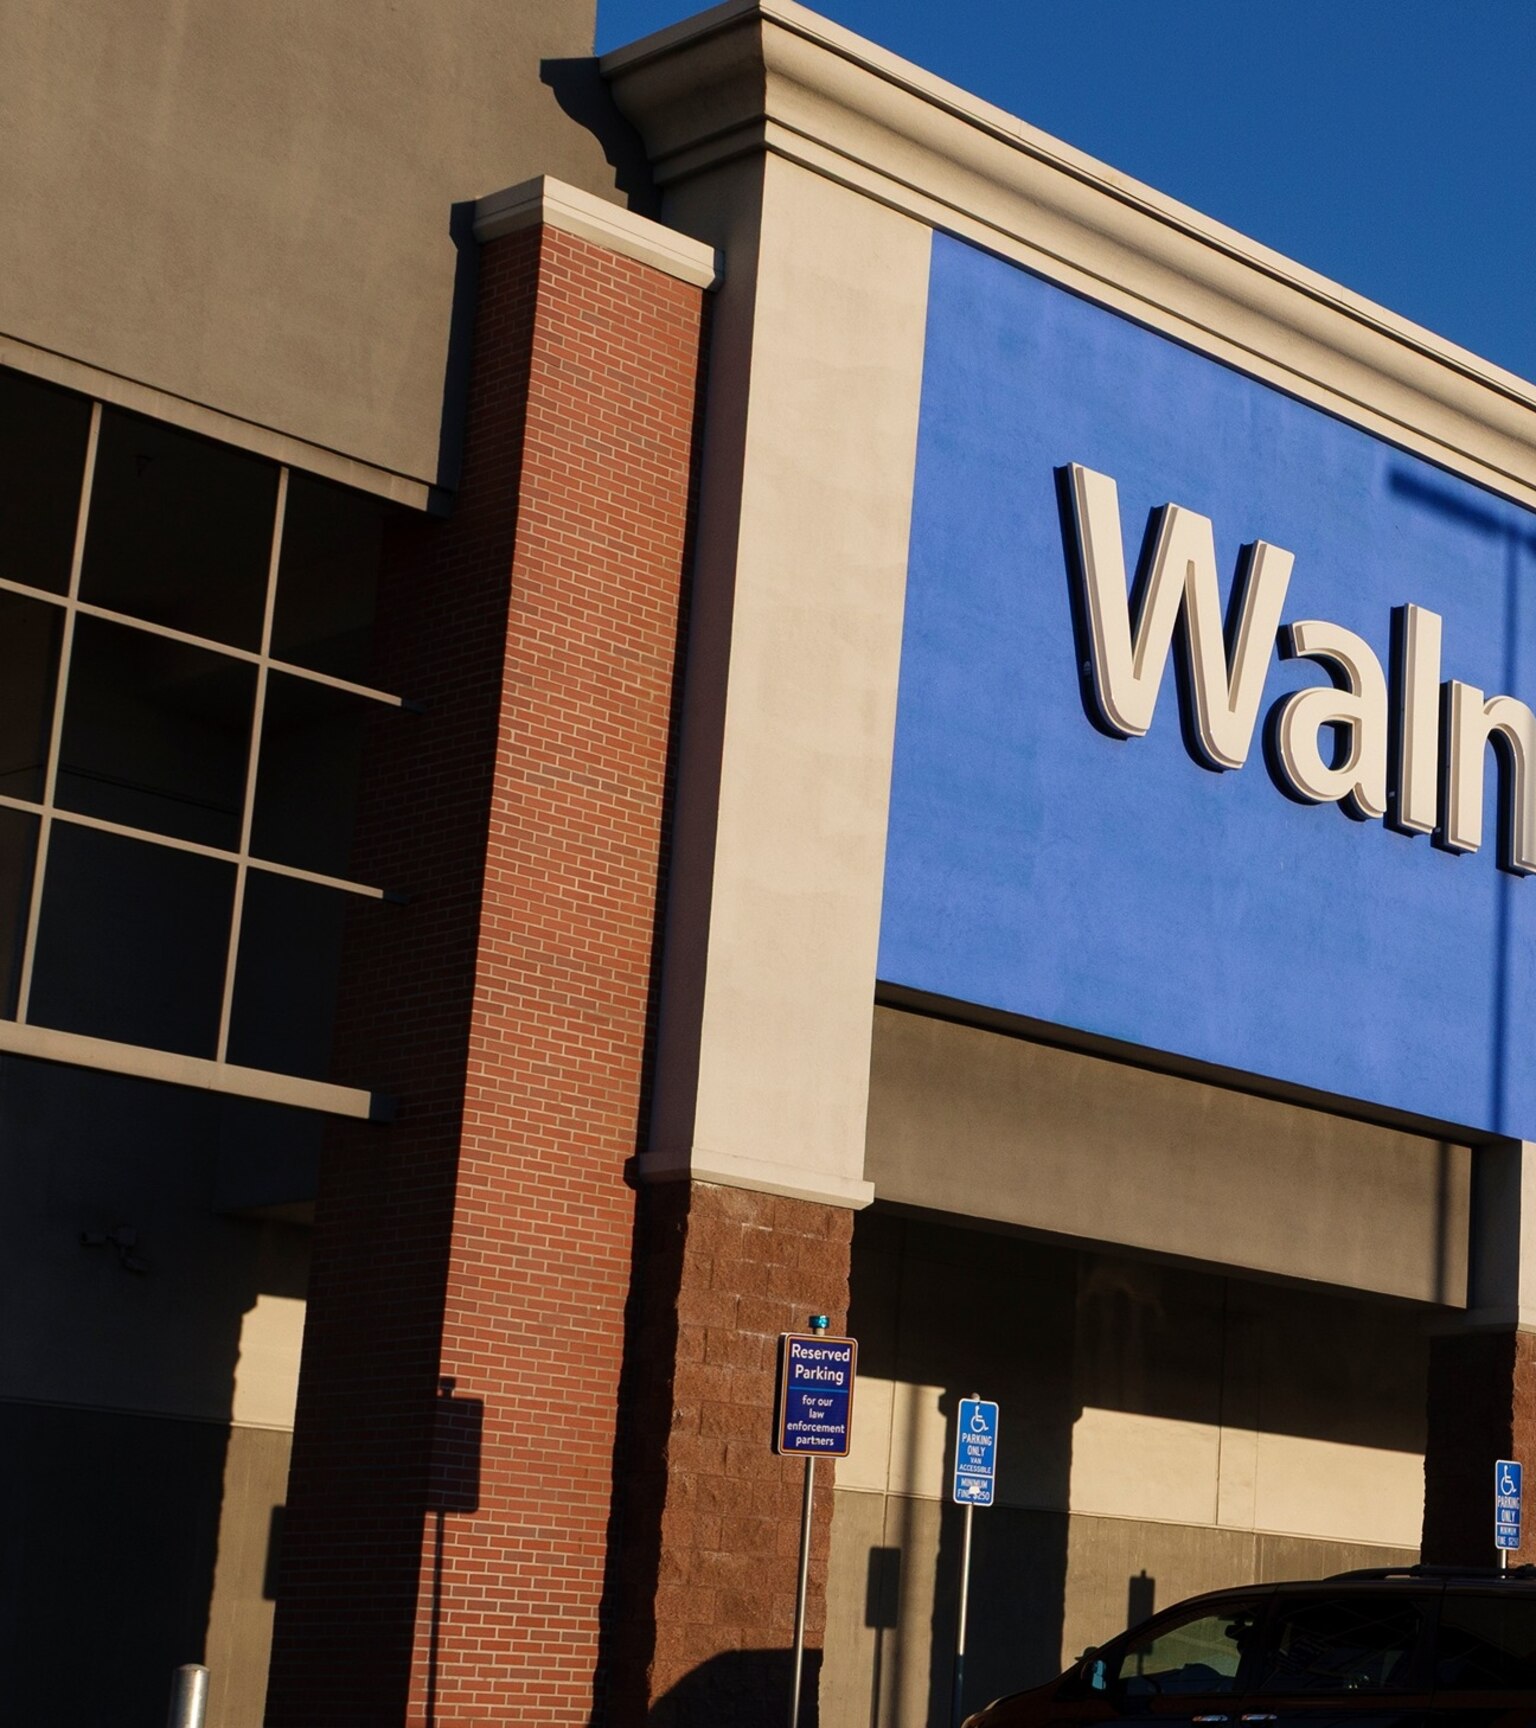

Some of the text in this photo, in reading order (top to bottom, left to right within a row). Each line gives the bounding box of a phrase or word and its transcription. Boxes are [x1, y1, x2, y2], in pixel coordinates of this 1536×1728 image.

[791, 1343, 850, 1362] Reserved
[795, 1364, 844, 1386] Parking
[802, 1395, 833, 1407] for our
[809, 1408, 825, 1419] law
[787, 1421, 845, 1434] enforcement
[795, 1436, 834, 1447] partners
[962, 1432, 993, 1447] PARKING
[967, 1445, 986, 1457] ONLY
[970, 1457, 982, 1465] VAN
[959, 1464, 992, 1474] ACCESSIBLE
[1497, 1496, 1520, 1509] PARKING
[1501, 1509, 1517, 1523] ONLY
